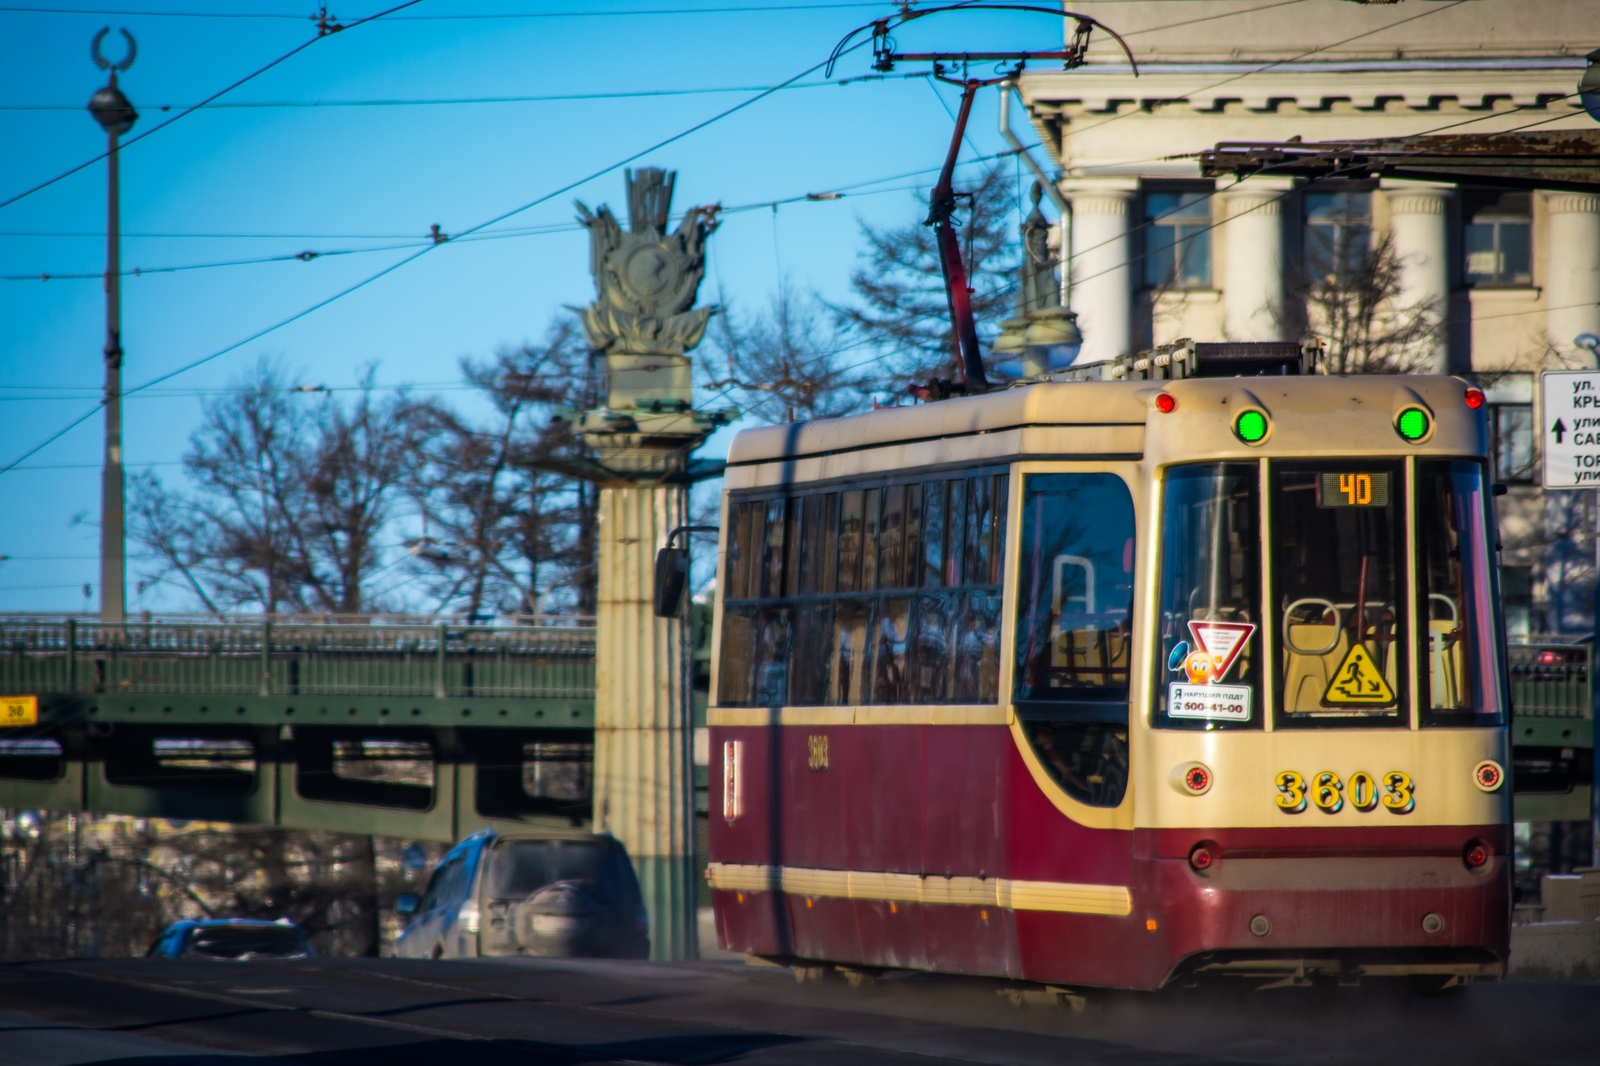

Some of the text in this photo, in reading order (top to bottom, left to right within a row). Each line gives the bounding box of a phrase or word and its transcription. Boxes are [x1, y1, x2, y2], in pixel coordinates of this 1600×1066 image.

[1572, 380, 1595, 394] ул.
[1339, 473, 1372, 505] 40
[1173, 688, 1244, 701] Я НАРУШИЛ ПДД?
[1184, 701, 1243, 714] 600-41-00
[1275, 770, 1415, 815] 3603
